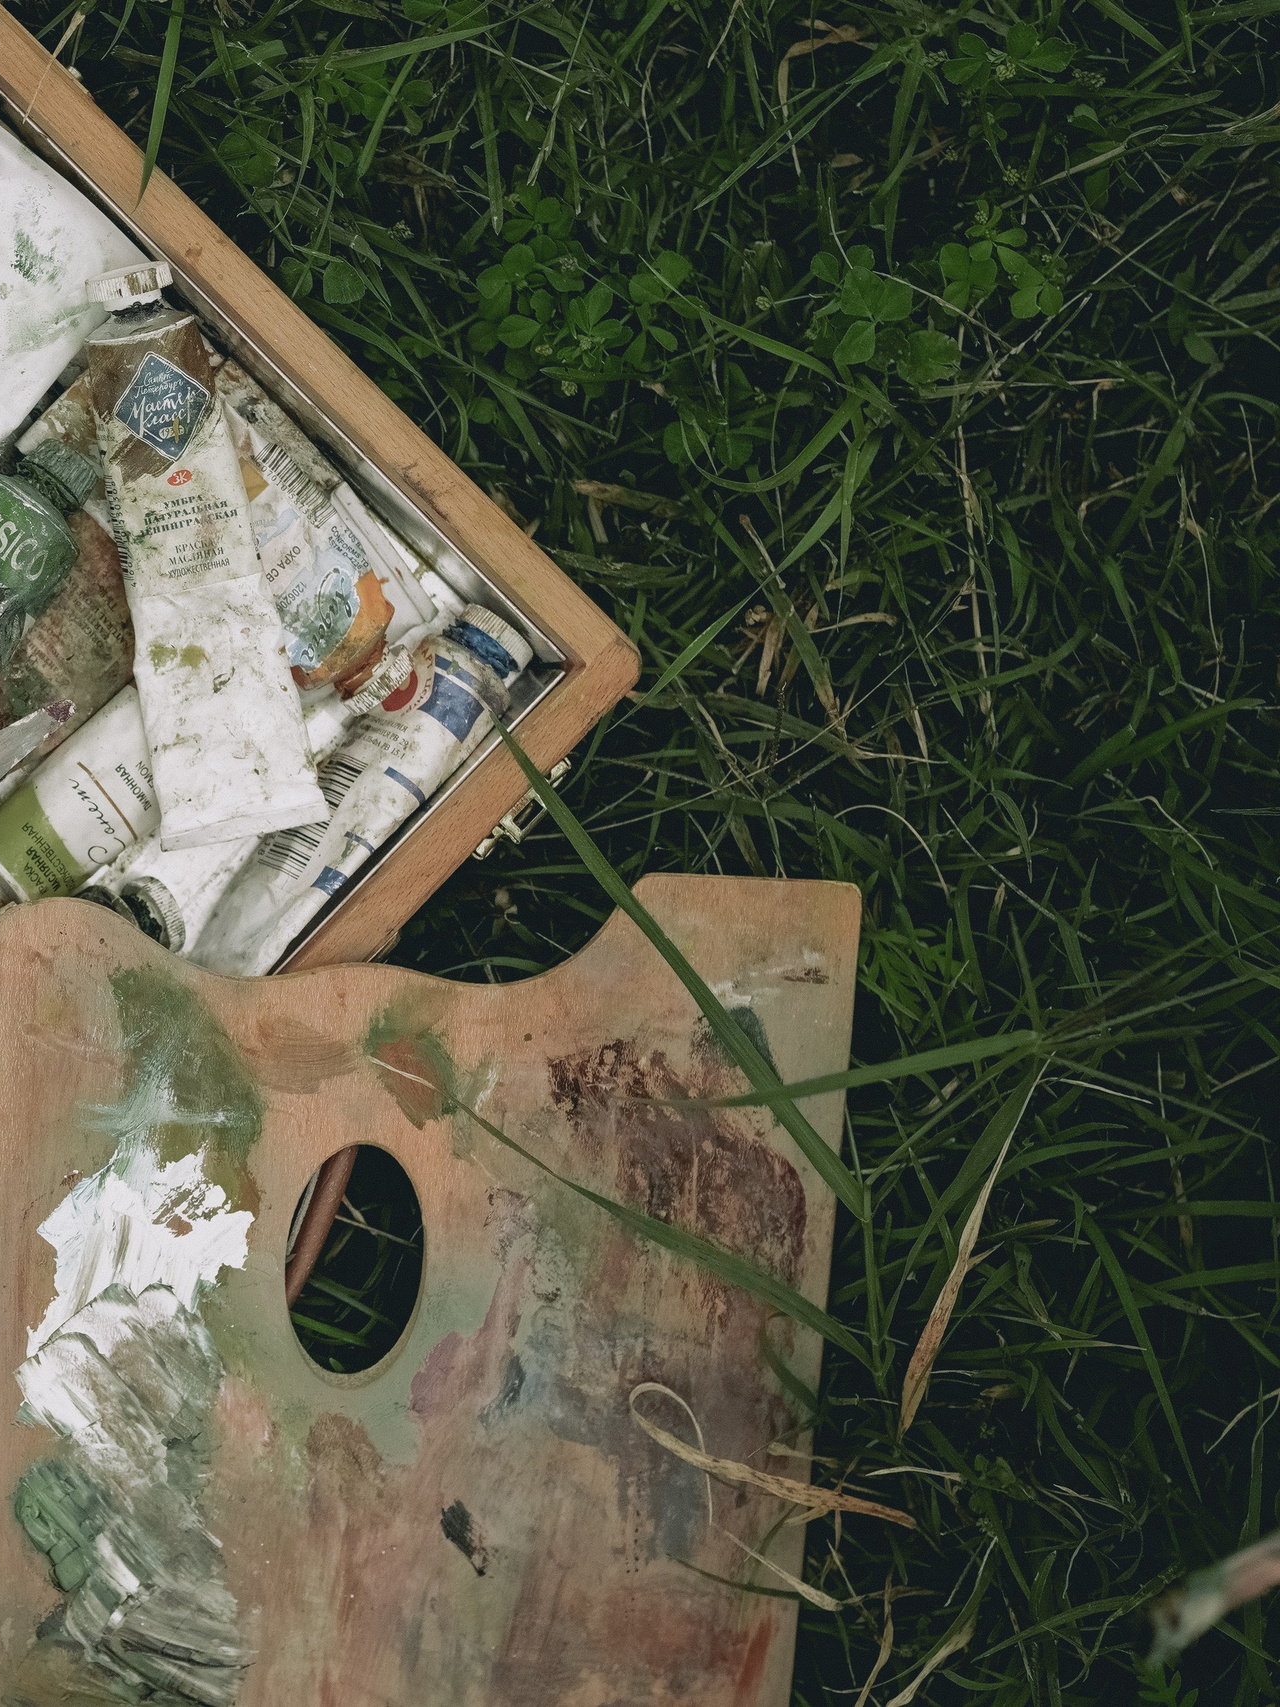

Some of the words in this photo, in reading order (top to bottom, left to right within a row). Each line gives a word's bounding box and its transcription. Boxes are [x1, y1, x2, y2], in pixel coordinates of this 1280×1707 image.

[263, 567, 280, 583] СВ
[275, 544, 302, 571] ОХРА
[111, 762, 156, 811] ЛИМОННАЯ
[133, 759, 159, 788] EMON
[19, 820, 80, 889] УДОЖЕСТВЕННАЯ
[23, 844, 65, 891] МАСЛЯНАЯ
